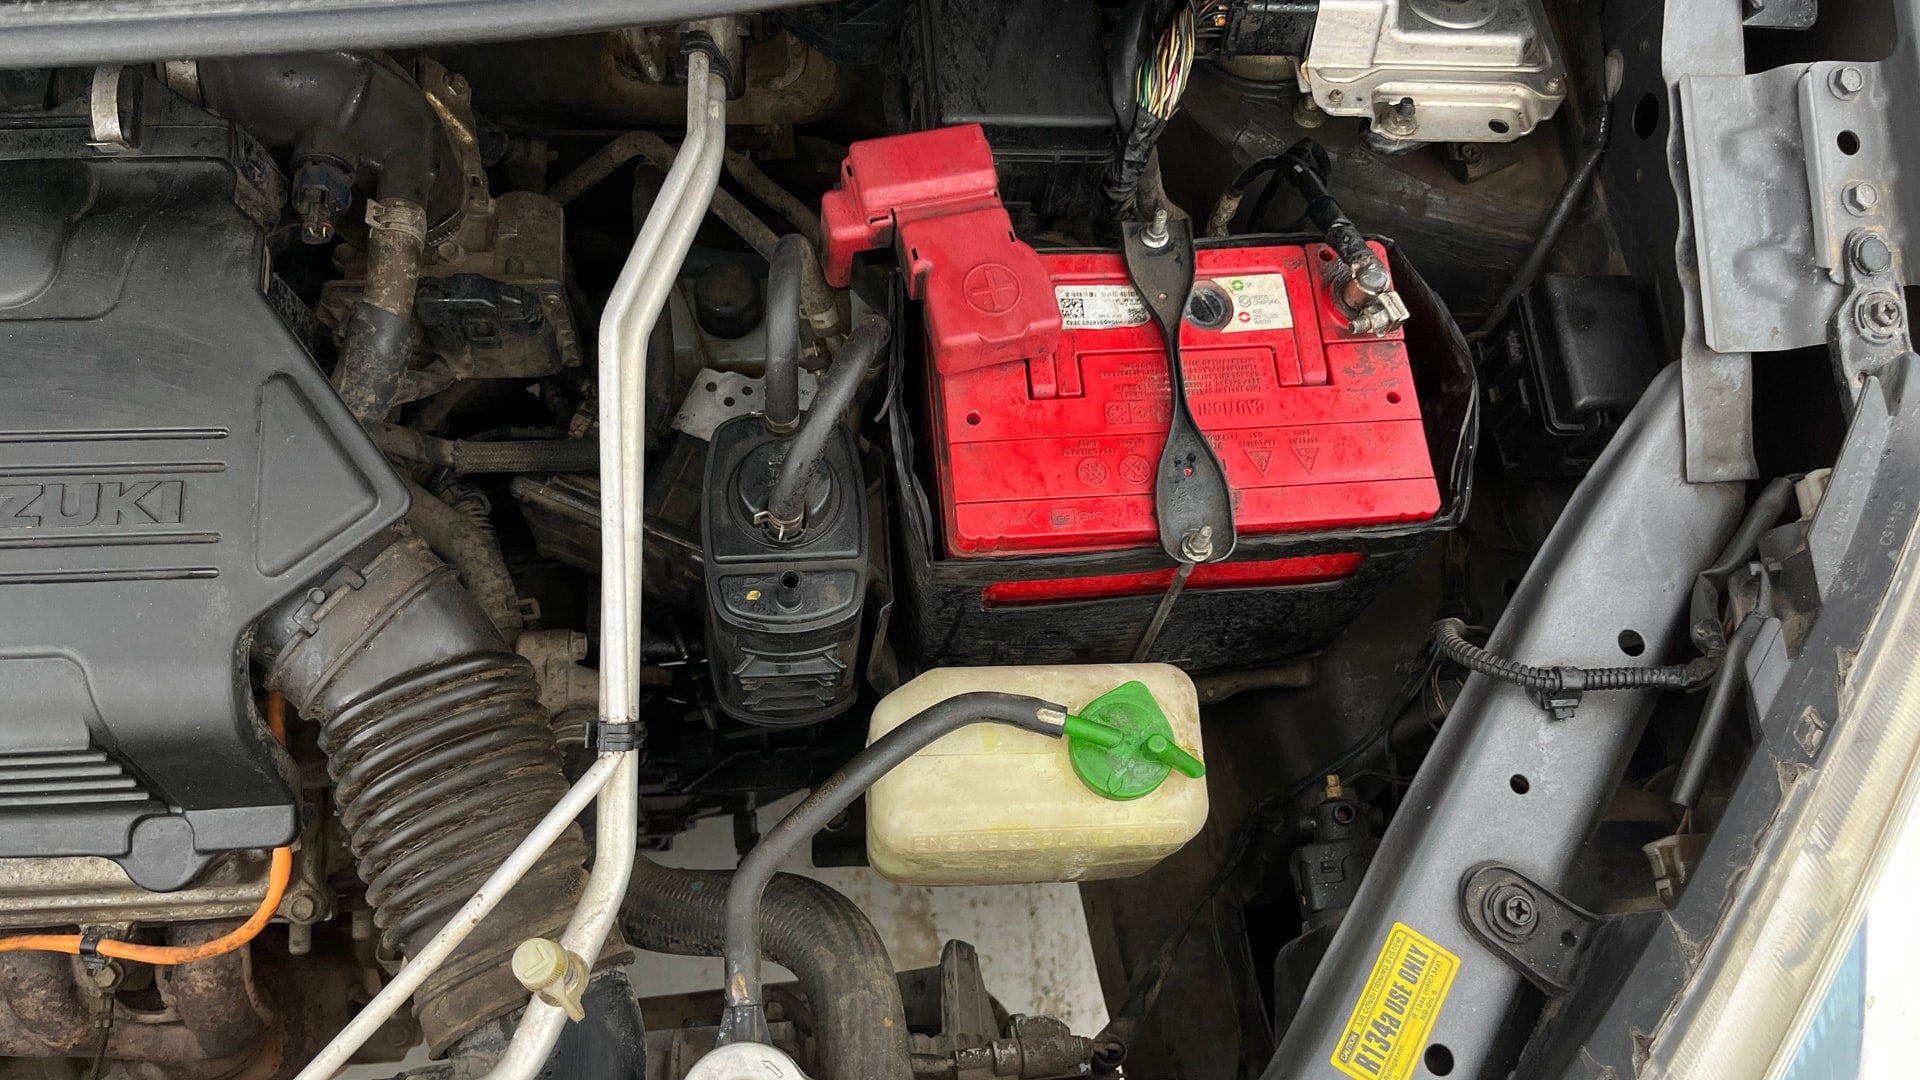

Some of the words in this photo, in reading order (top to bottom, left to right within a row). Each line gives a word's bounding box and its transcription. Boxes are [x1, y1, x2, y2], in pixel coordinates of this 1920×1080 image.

[1197, 400, 1267, 416] CAUTION!
[914, 833, 999, 850] ENGINE
[1010, 831, 1115, 848] COOLANT
[1397, 943, 1429, 986] ONLY
[1339, 1033, 1359, 1062] CAUTION
[1356, 1012, 1367, 1028] AIR
[1364, 965, 1389, 1015] CONDITIONING
[1386, 937, 1402, 965] SYSTEM
[1384, 980, 1413, 1016] USE
[1354, 1011, 1402, 1076] R134a
